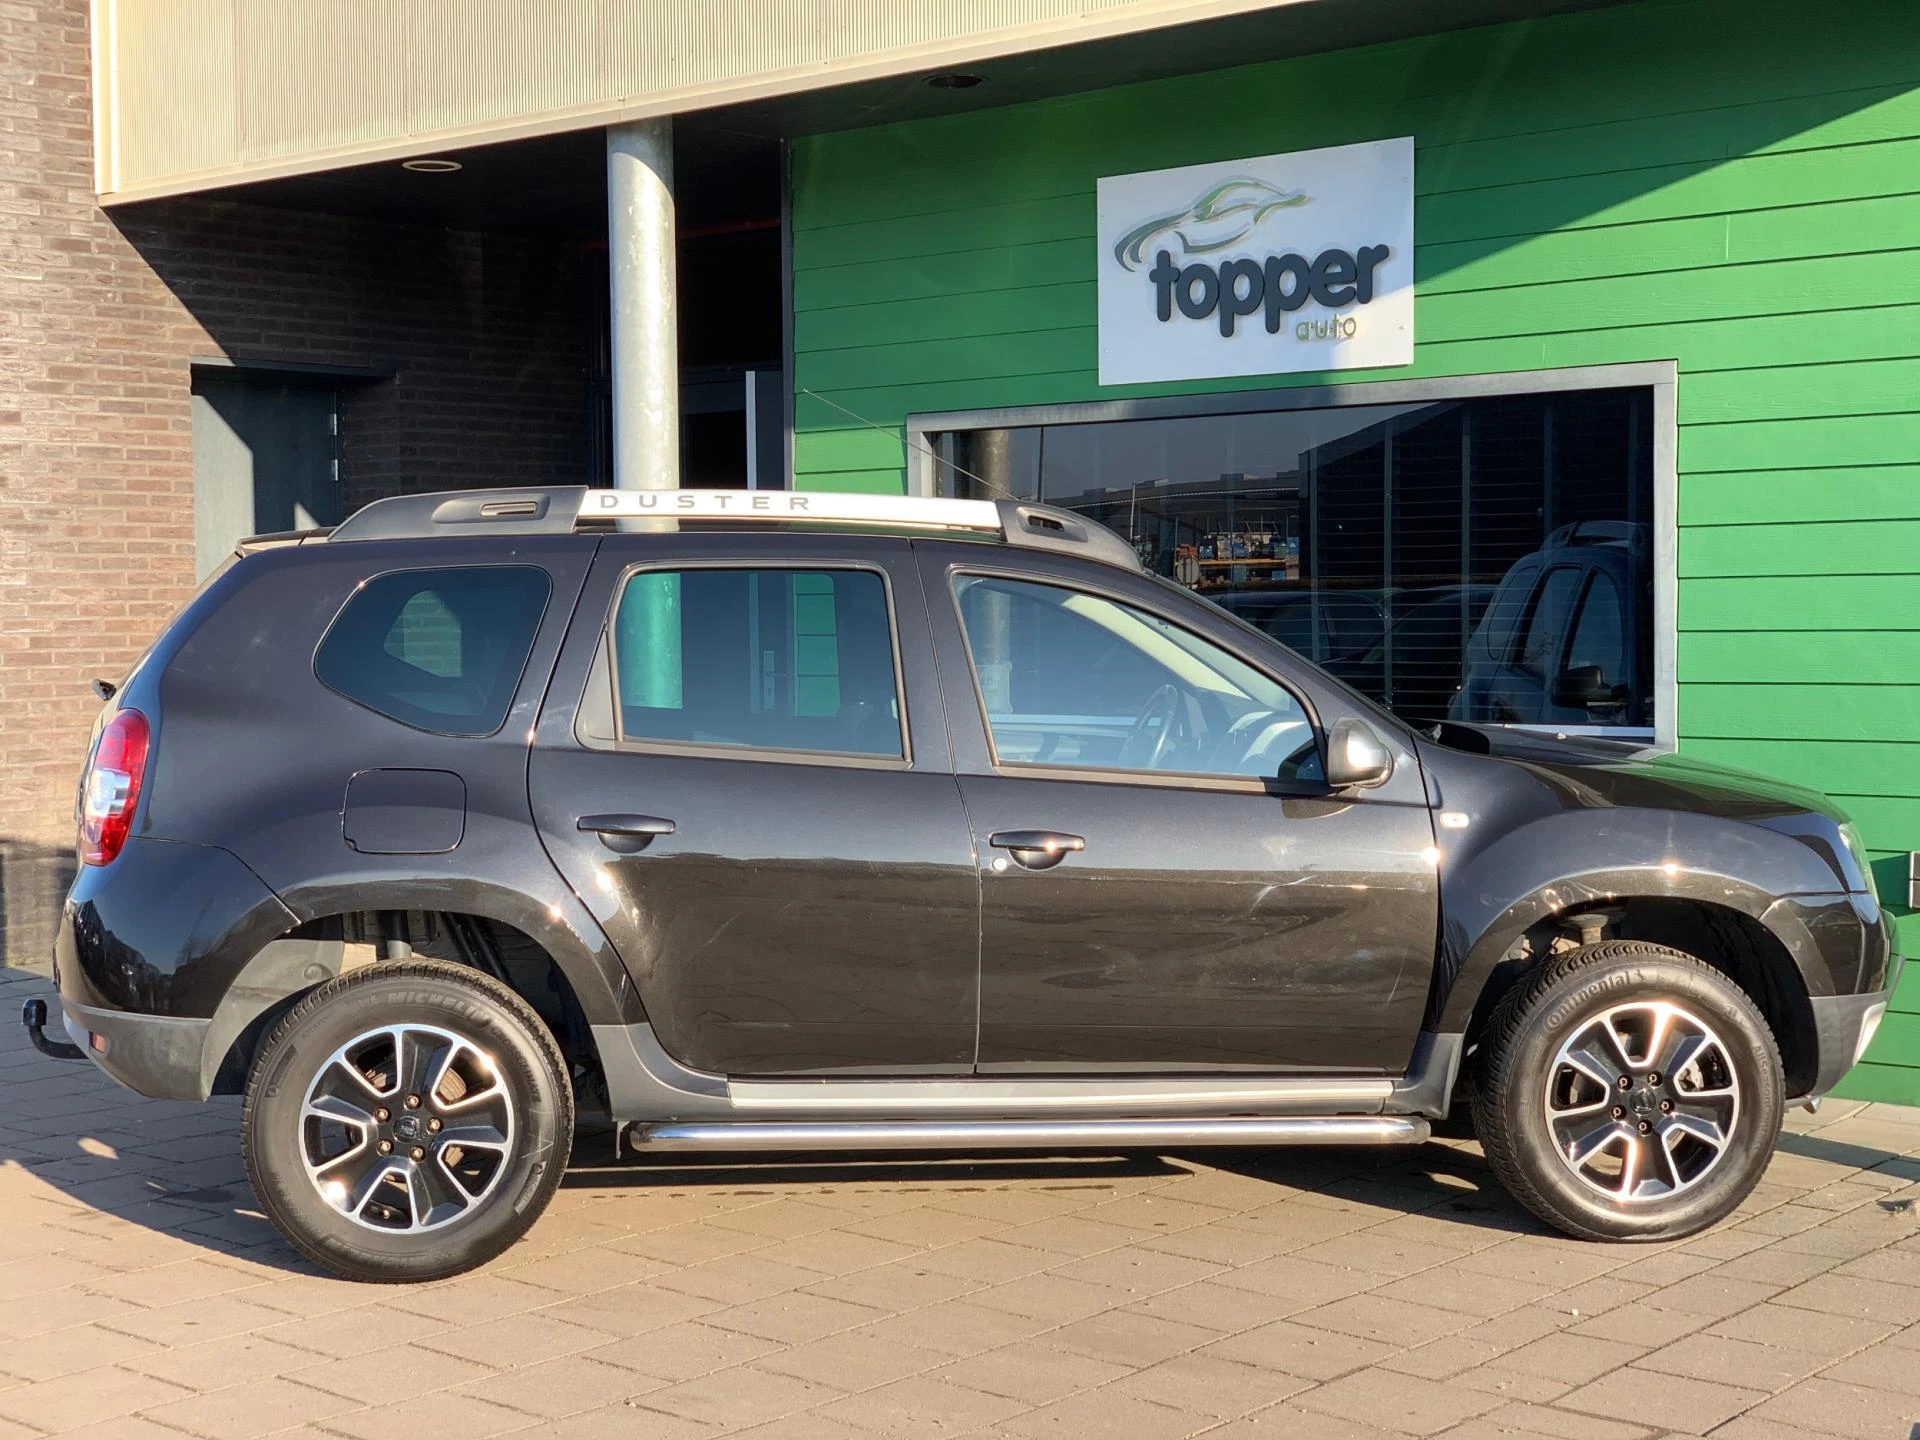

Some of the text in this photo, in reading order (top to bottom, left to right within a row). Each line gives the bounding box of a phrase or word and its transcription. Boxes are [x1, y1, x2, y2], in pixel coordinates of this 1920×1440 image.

[1149, 244, 1390, 338] topper
[1296, 314, 1357, 341] auto
[600, 494, 809, 511] DUSTER
[387, 990, 493, 1023] MICHELIN
[1544, 970, 1632, 1032] Continental
